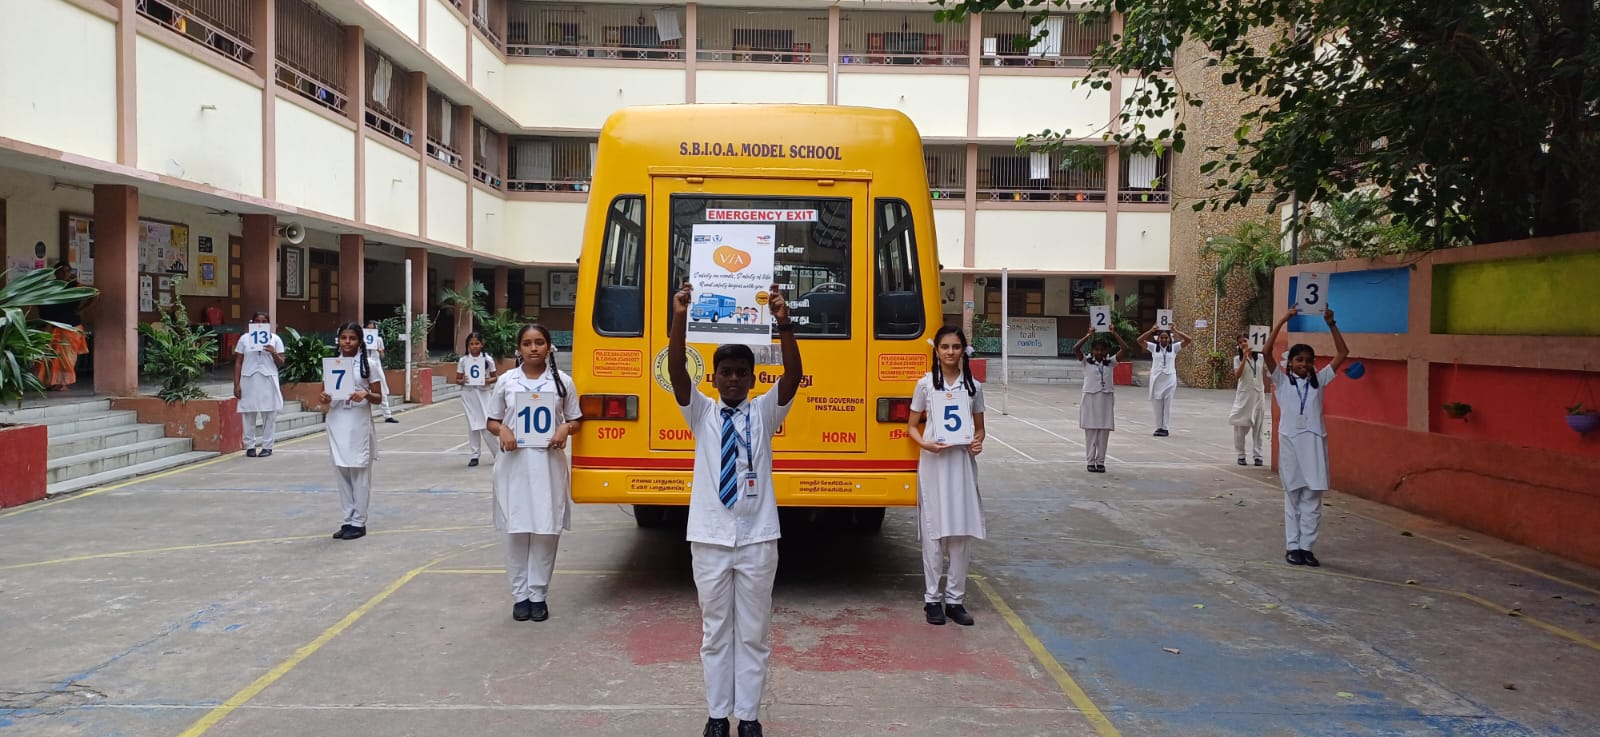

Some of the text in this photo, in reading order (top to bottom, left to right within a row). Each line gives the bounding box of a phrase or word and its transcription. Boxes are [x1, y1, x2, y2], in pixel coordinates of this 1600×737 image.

[679, 142, 842, 160] S.B.I.O.A. MODEL SCHOOL
[708, 210, 814, 221] EMERGENCY EXIT
[1304, 283, 1319, 305] 3
[1096, 313, 1106, 326] 2
[1160, 315, 1168, 326] 8
[250, 330, 269, 345] 13
[366, 334, 374, 344] 9
[1252, 332, 1267, 345] 11
[470, 364, 480, 378] 6
[331, 369, 346, 390] 7
[829, 397, 864, 405] GOVERNOR
[517, 406, 552, 434] 10
[944, 405, 962, 432] 5
[598, 427, 626, 439] STOP
[659, 429, 694, 440] SOUN
[822, 432, 856, 443] HORN
